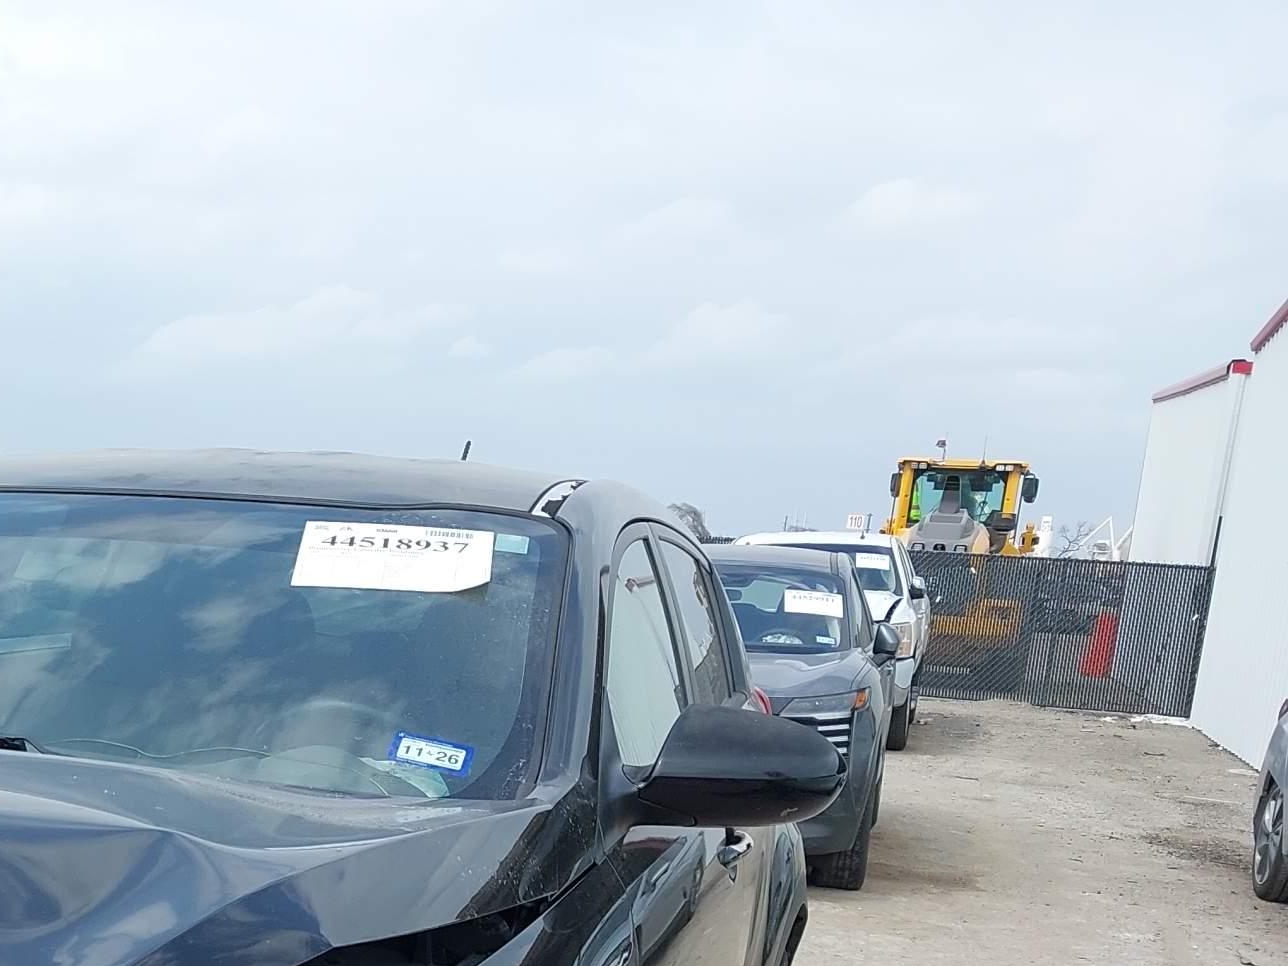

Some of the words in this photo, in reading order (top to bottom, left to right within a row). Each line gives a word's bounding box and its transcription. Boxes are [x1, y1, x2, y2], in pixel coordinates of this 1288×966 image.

[849, 515, 863, 529] 110
[320, 534, 470, 554] 44518937
[403, 744, 424, 758] 11
[434, 750, 461, 765] 26
